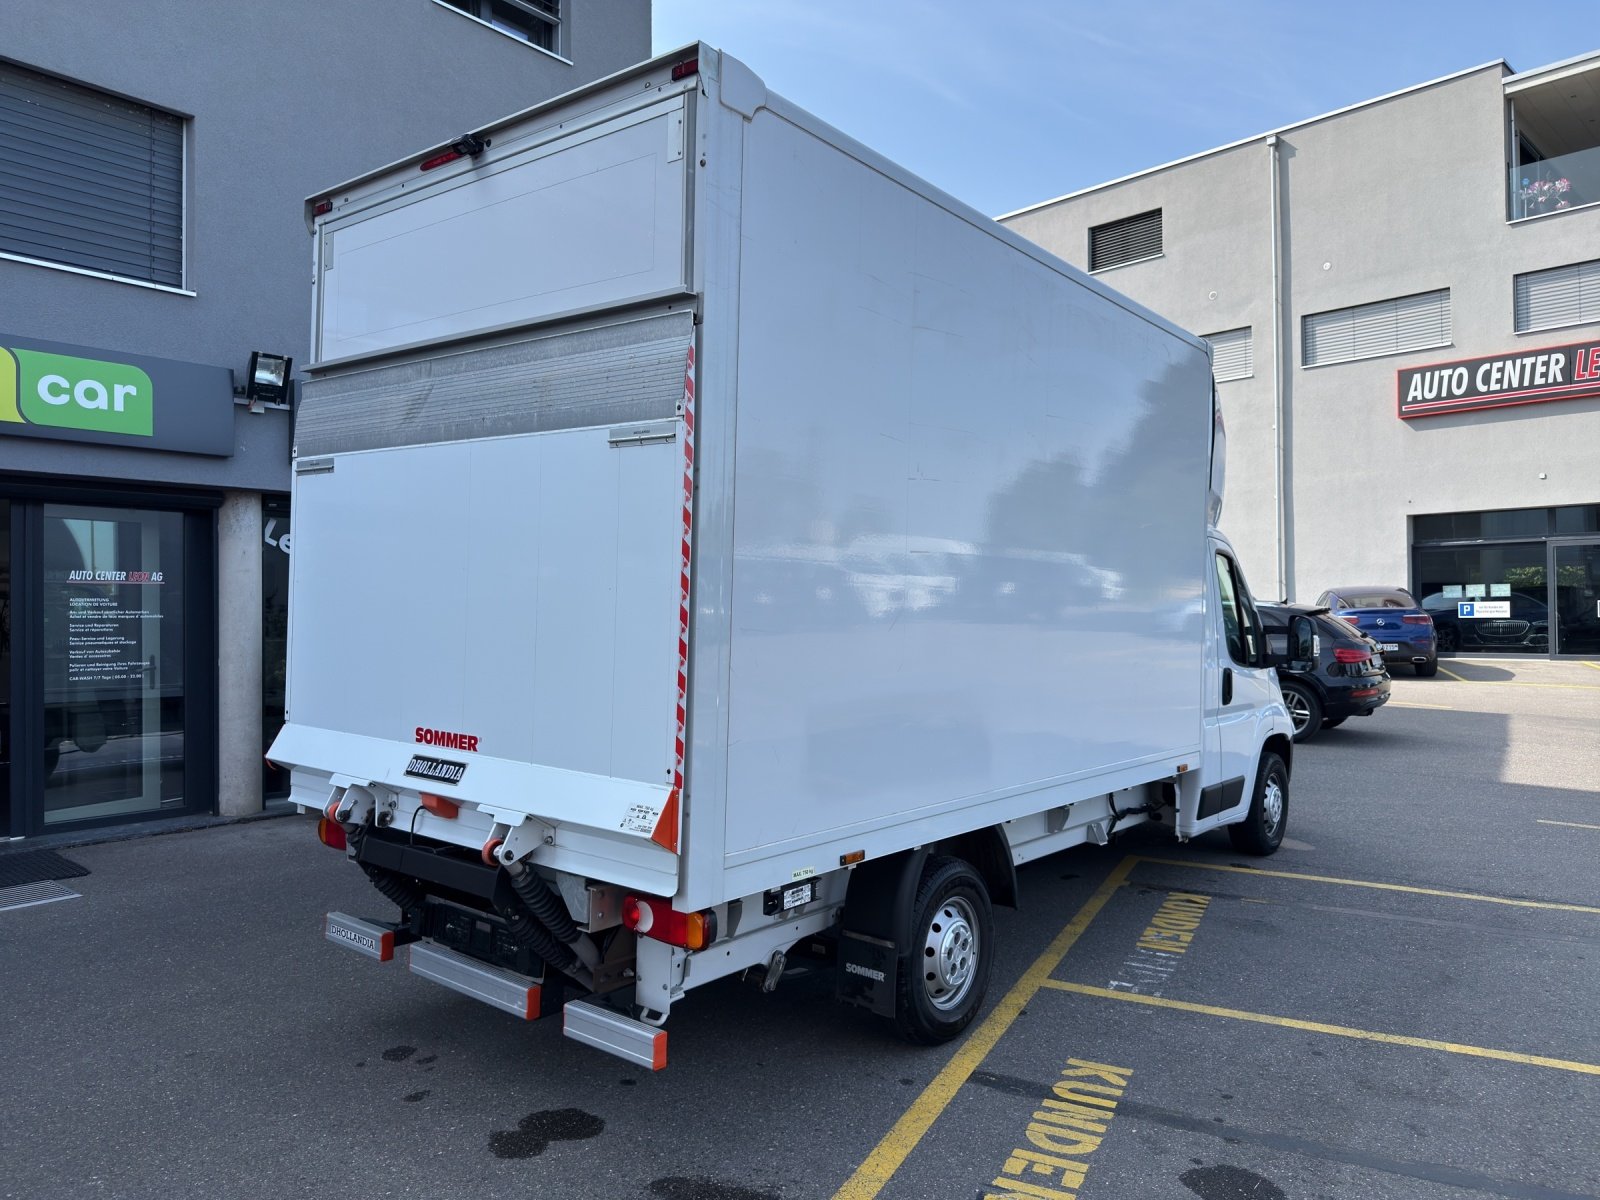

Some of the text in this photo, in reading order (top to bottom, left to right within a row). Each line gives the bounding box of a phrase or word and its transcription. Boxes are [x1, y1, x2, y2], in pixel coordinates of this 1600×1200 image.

[1407, 366, 1468, 402] AUTO
[1476, 353, 1566, 392] CENTER
[37, 374, 137, 412] car
[69, 570, 93, 580] AUTO
[96, 571, 126, 580] CENTER
[151, 572, 163, 582] AG
[415, 727, 478, 752] SOMMER
[407, 759, 464, 780] DHOLLANDIA
[331, 925, 375, 950] DHOLLANDIA
[845, 962, 885, 982] SOMMER
